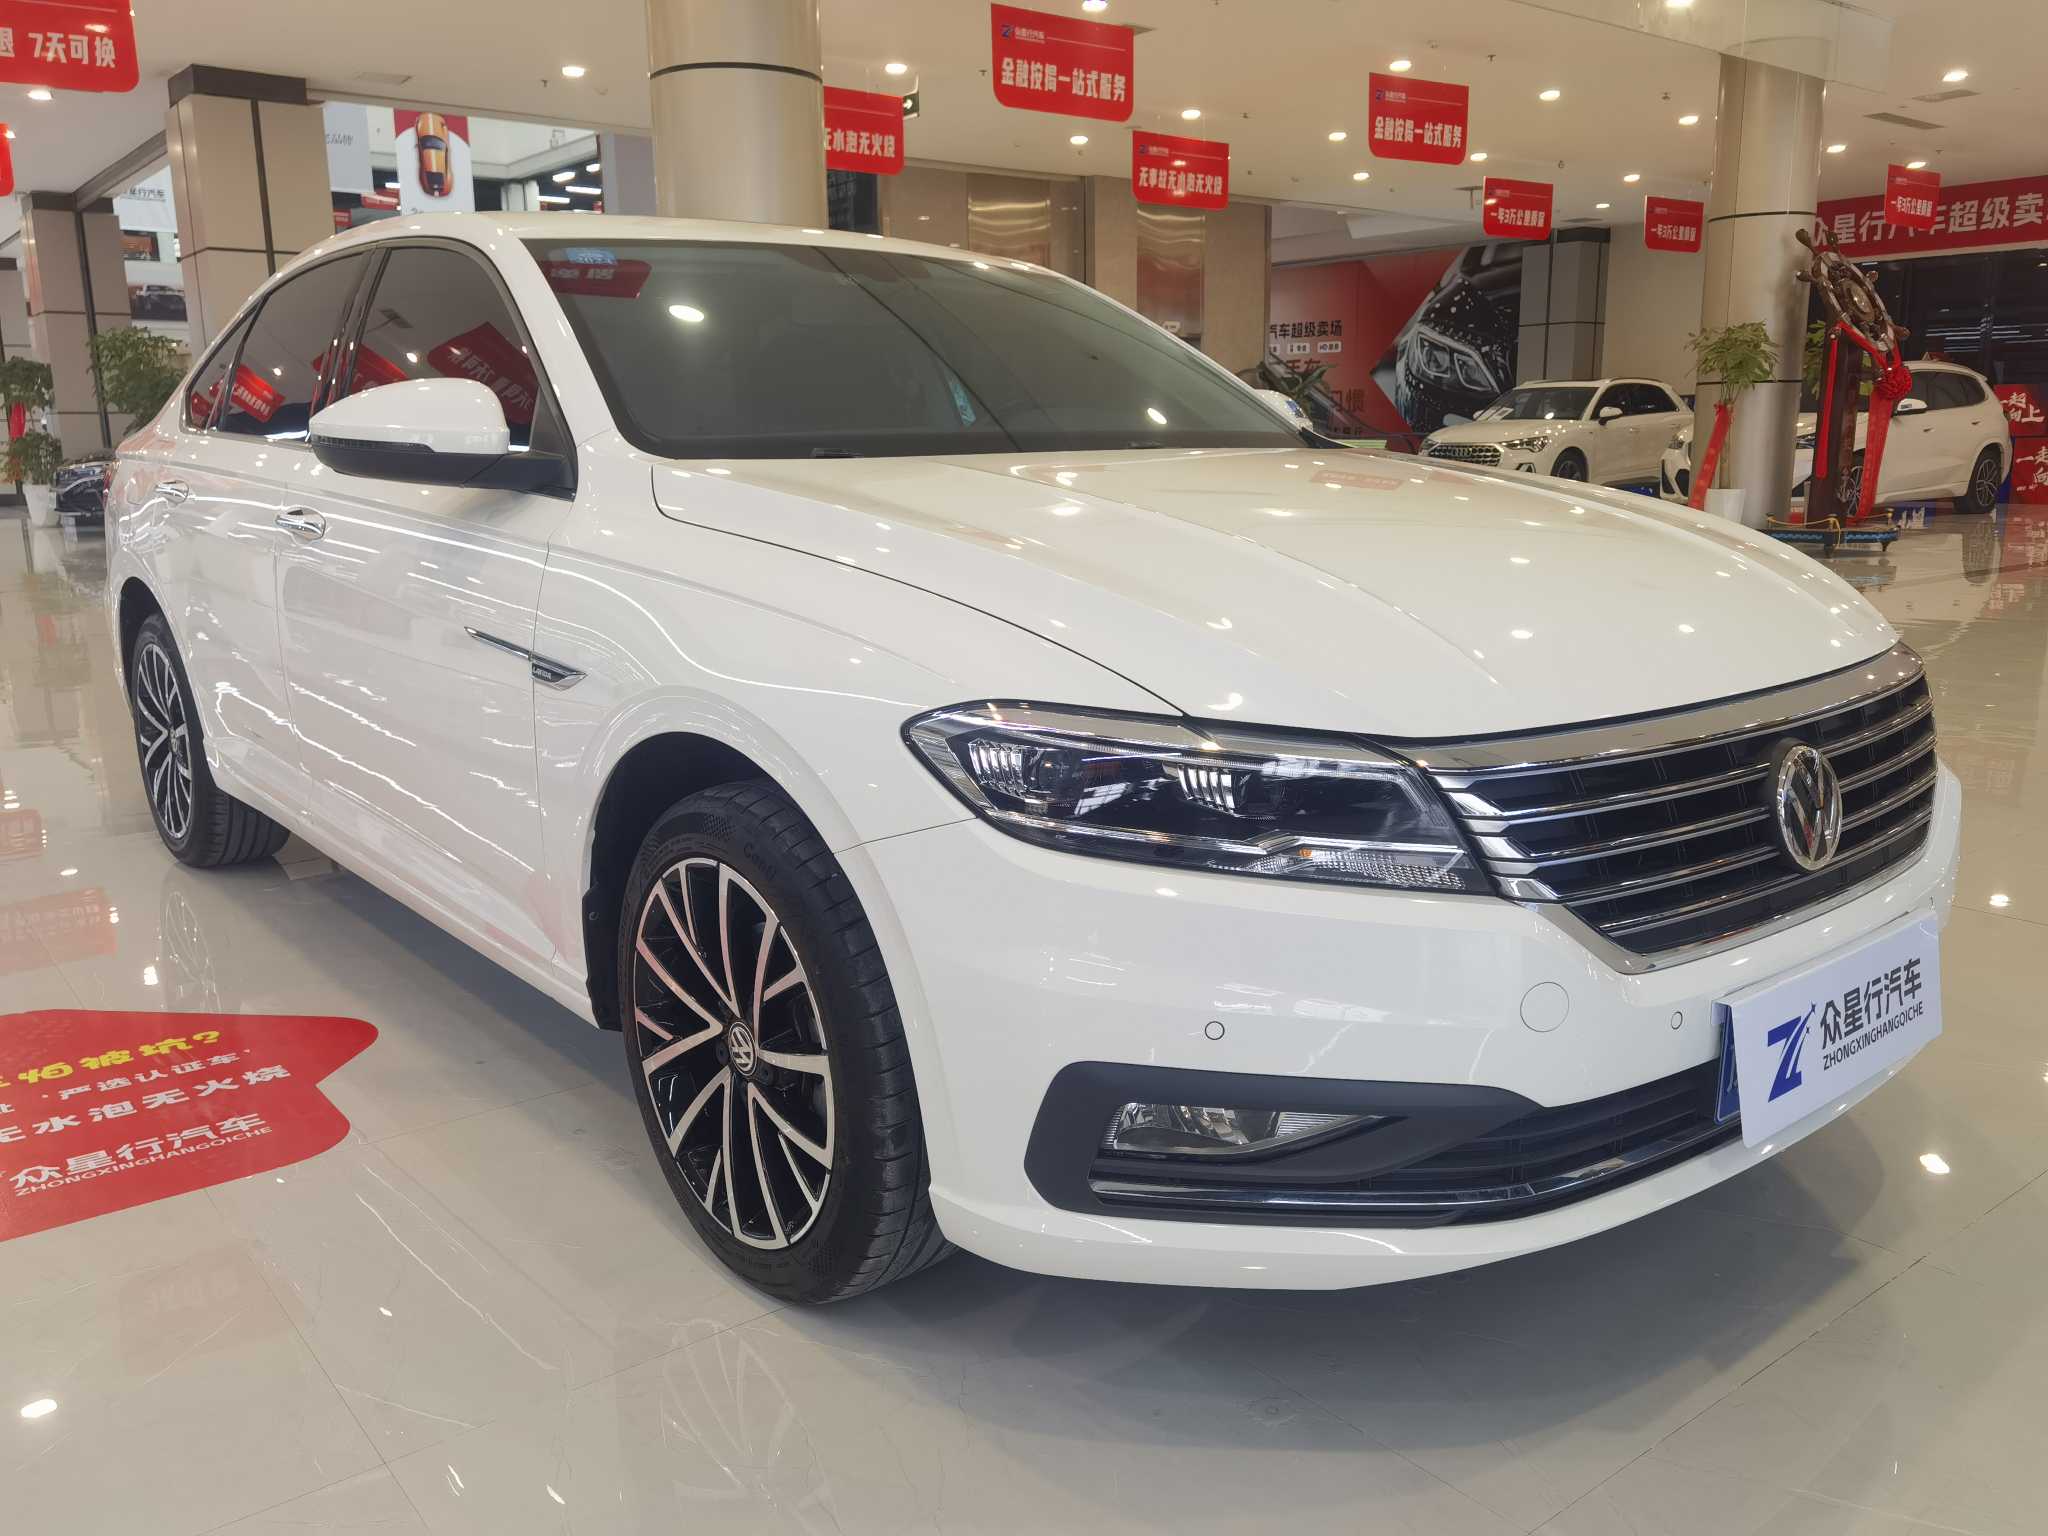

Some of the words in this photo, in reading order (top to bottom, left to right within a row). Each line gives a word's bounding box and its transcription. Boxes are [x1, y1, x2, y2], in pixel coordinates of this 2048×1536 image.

[27, 31, 116, 69] 7天可换
[1001, 57, 1126, 102] 金融按揭一站式服务
[1374, 116, 1463, 148] 金融按揭一站式服务
[1820, 958, 1922, 1050] 众星行汽车
[0, 1030, 220, 1088] 怕被坑？
[1823, 1001, 1924, 1071] ZHONGXINGHANGQICHE
[9, 1113, 268, 1190] 众星行汽车
